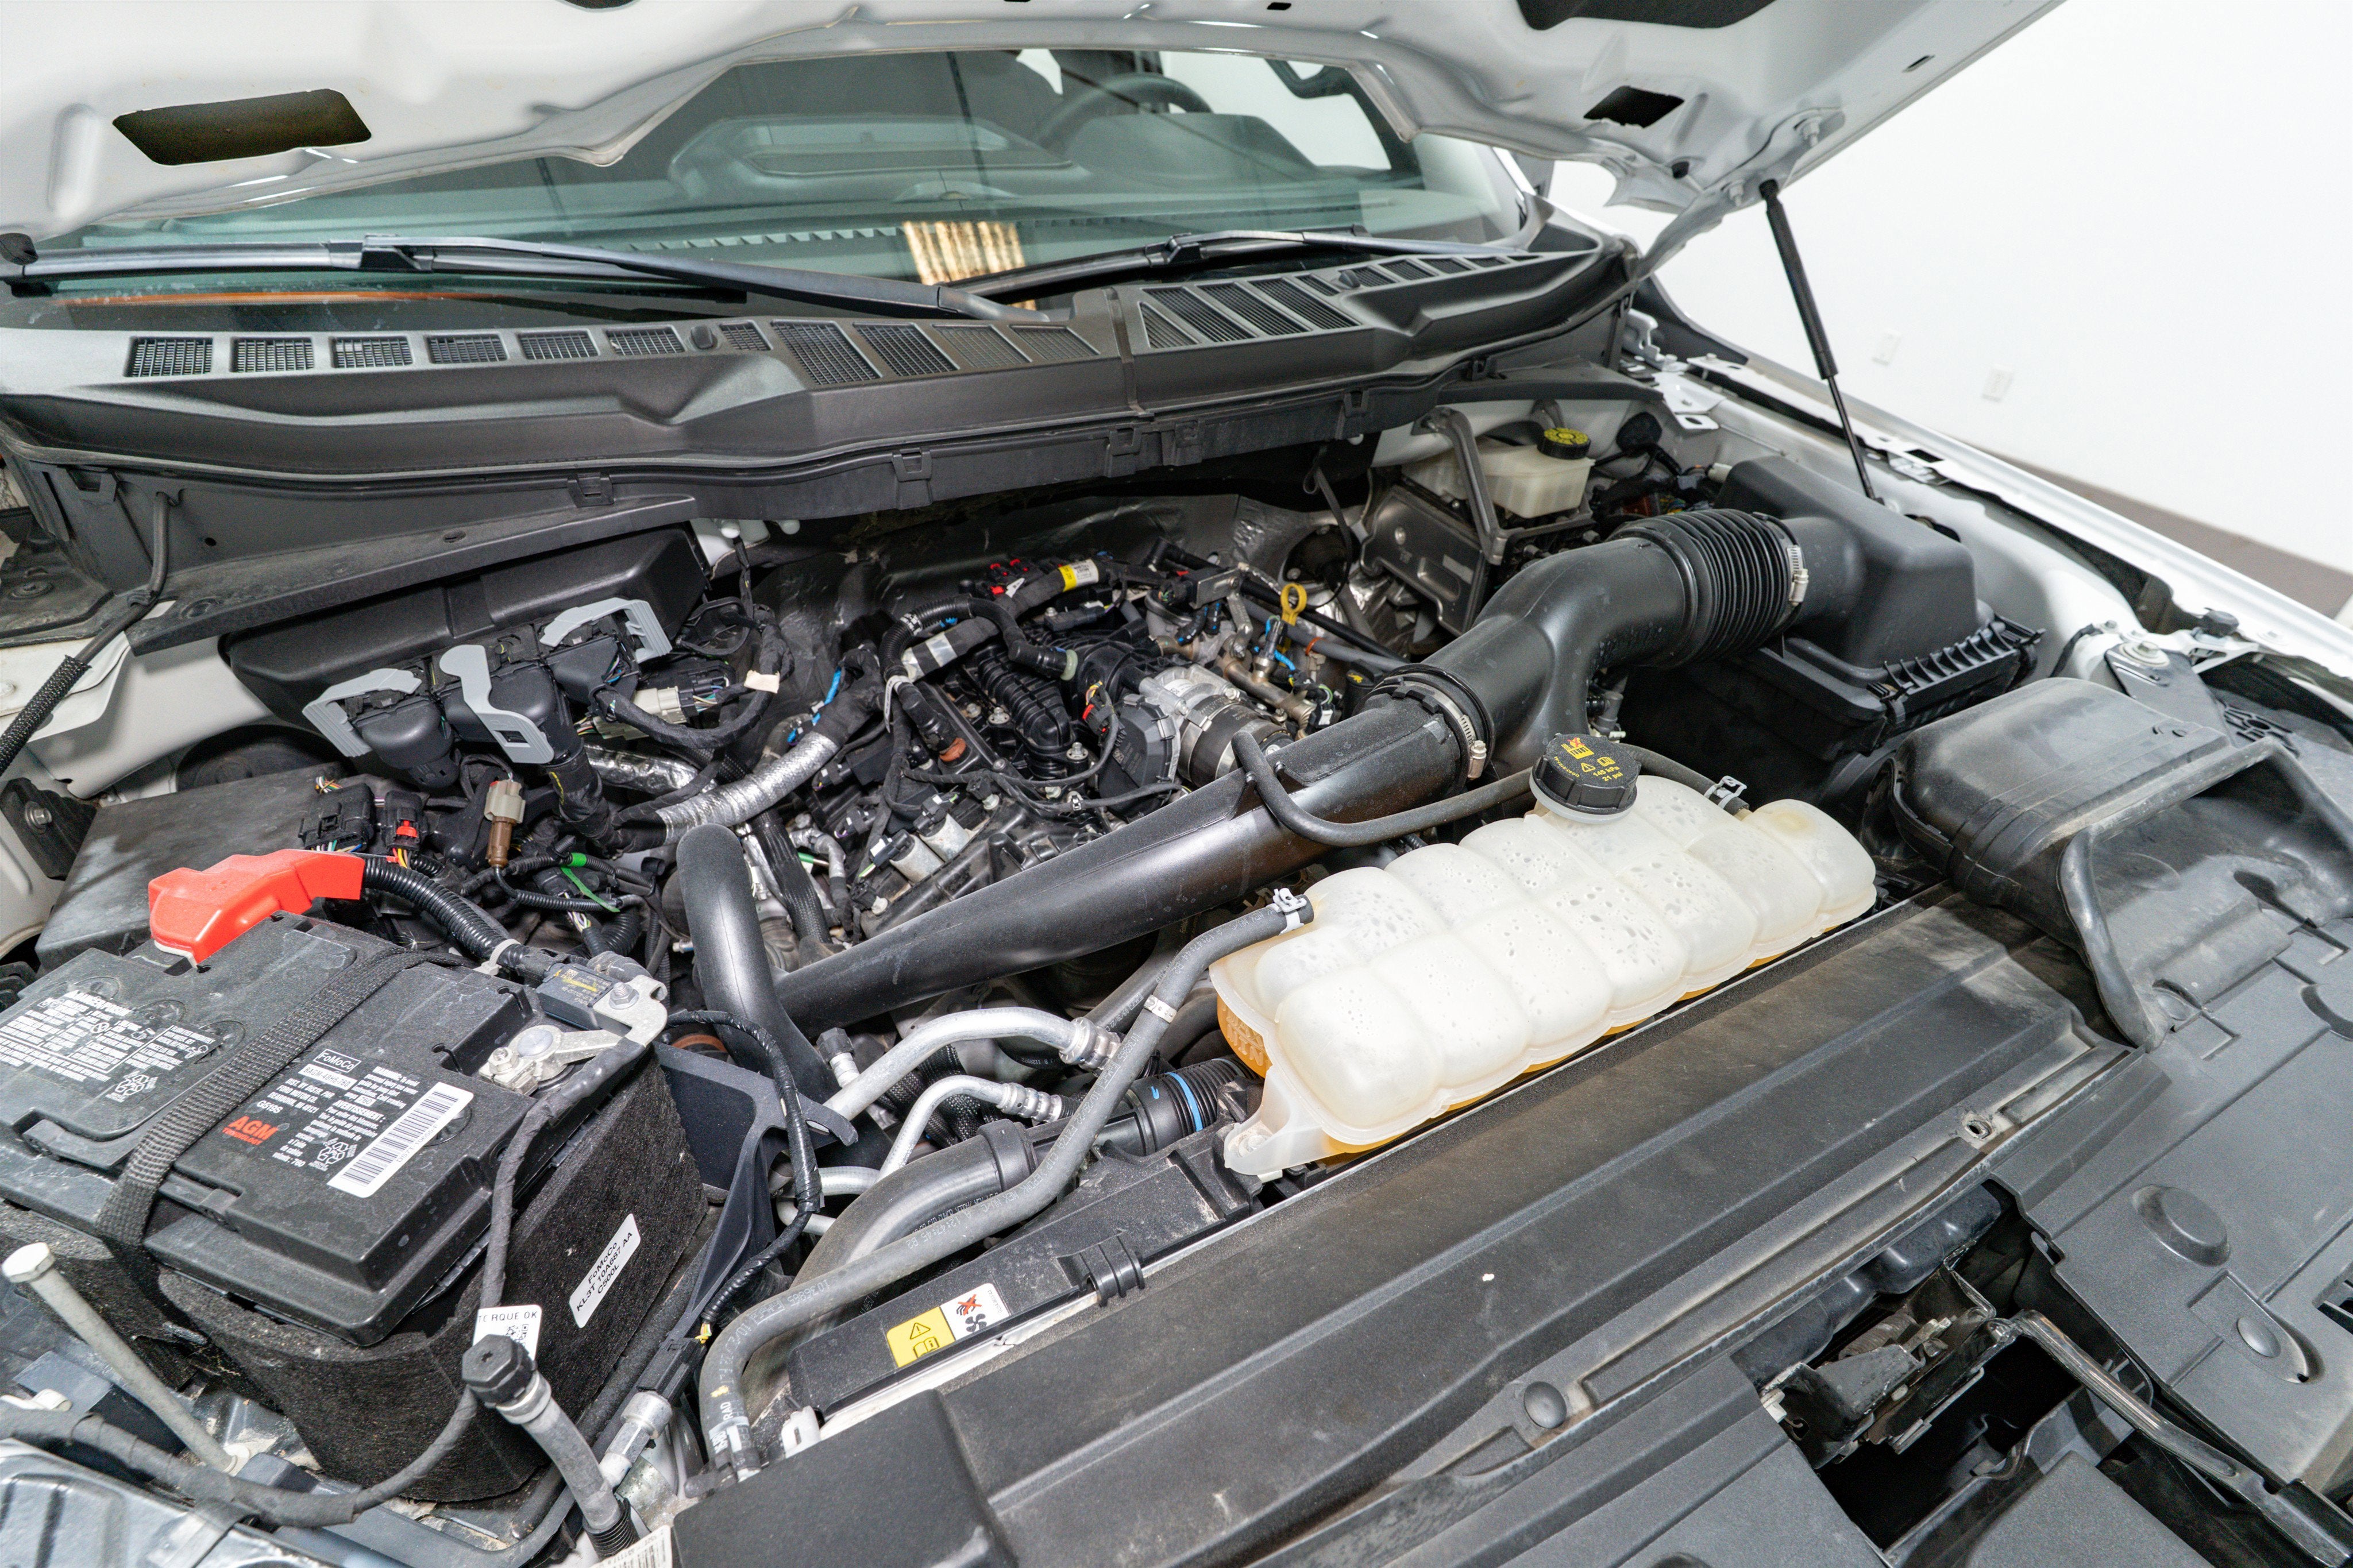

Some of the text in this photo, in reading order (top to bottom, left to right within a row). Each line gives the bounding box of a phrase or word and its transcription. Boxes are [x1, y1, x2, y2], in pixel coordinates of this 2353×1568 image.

[1593, 766, 1620, 777] 145 kPa
[1613, 772, 1624, 780] psi
[1117, 1033, 1141, 1061] 1036865
[1226, 1023, 1264, 1067] MIN
[318, 1052, 354, 1069] FoMoCo
[304, 1067, 351, 1087] BAGM-48H6-760
[267, 1092, 298, 1107] DEARBORN,
[276, 1085, 318, 1103] FORD MOTOR CO.
[361, 1097, 372, 1105] 760
[257, 1100, 284, 1114] G519S
[228, 1116, 279, 1140] AGM
[291, 1158, 306, 1167] 760
[920, 1216, 961, 1242] 12:47:45
[905, 1238, 919, 1249] B2
[577, 1232, 632, 1312] KL3T 10A687 AA
[588, 1242, 618, 1284] FoMoCo
[597, 1265, 620, 1295] C500L
[787, 1280, 830, 1304] 1036865
[523, 1311, 538, 1319] OK
[720, 1401, 734, 1421] RAD
